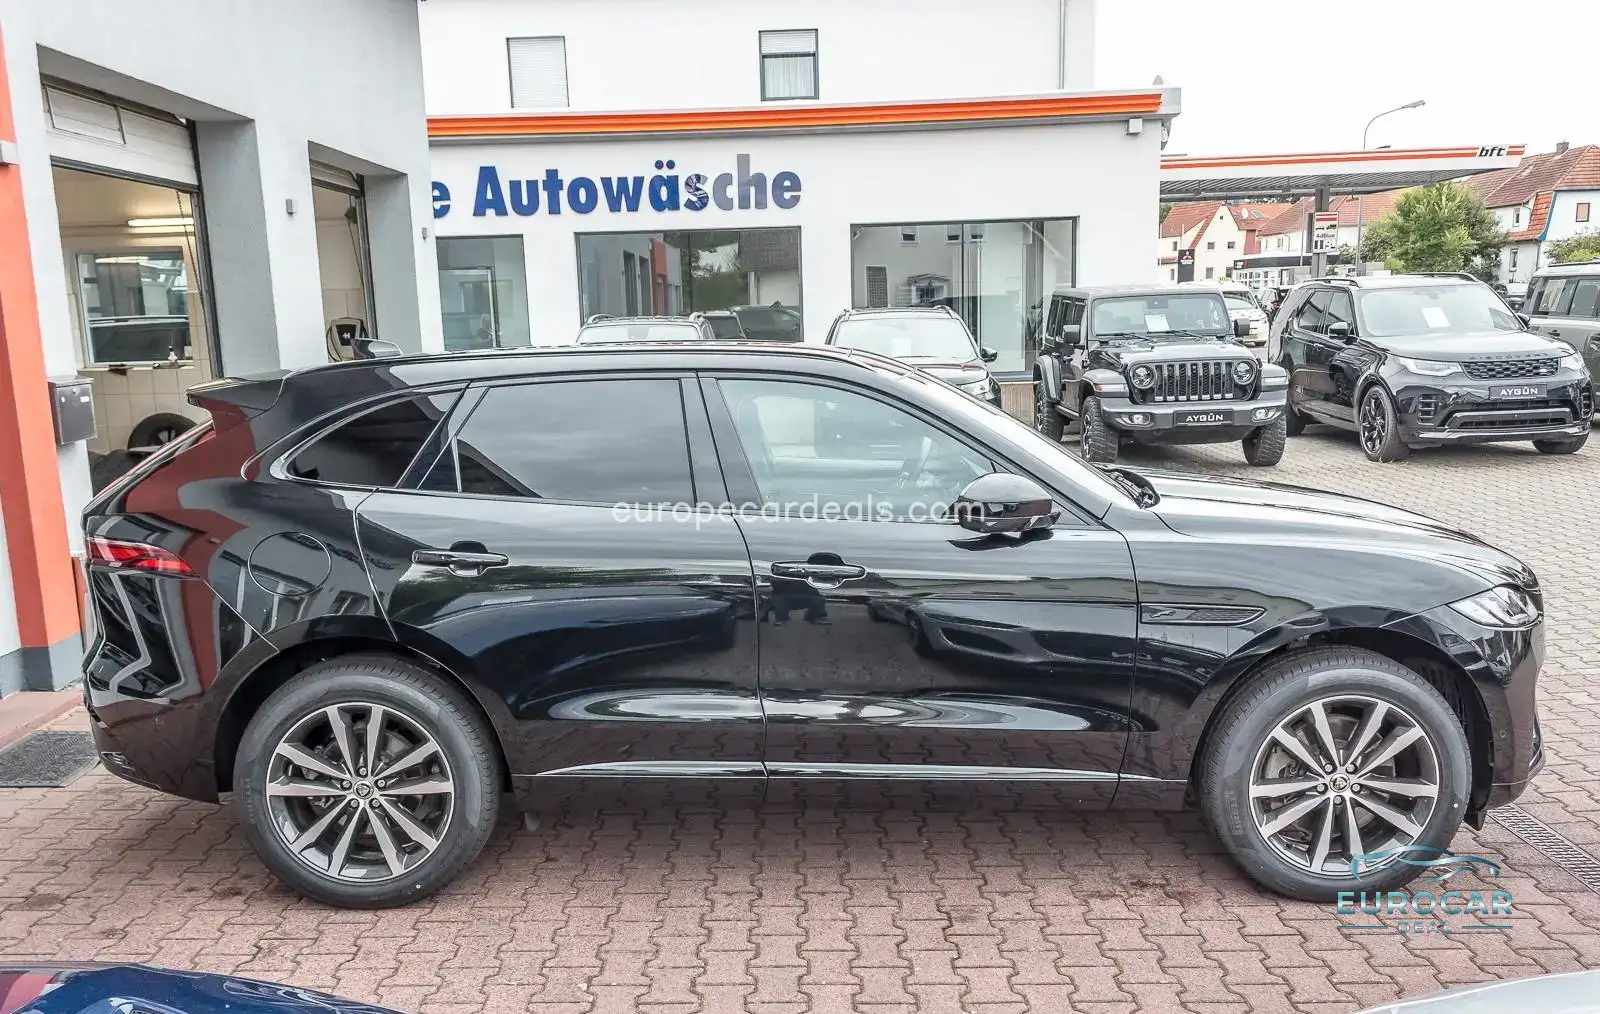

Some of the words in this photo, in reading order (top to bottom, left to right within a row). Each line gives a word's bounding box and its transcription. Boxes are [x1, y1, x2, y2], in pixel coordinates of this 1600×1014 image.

[1479, 146, 1505, 157] bft
[473, 154, 802, 217] Autowäsche
[1499, 386, 1538, 396] AYGÜN
[1186, 413, 1223, 422] AYGÜN
